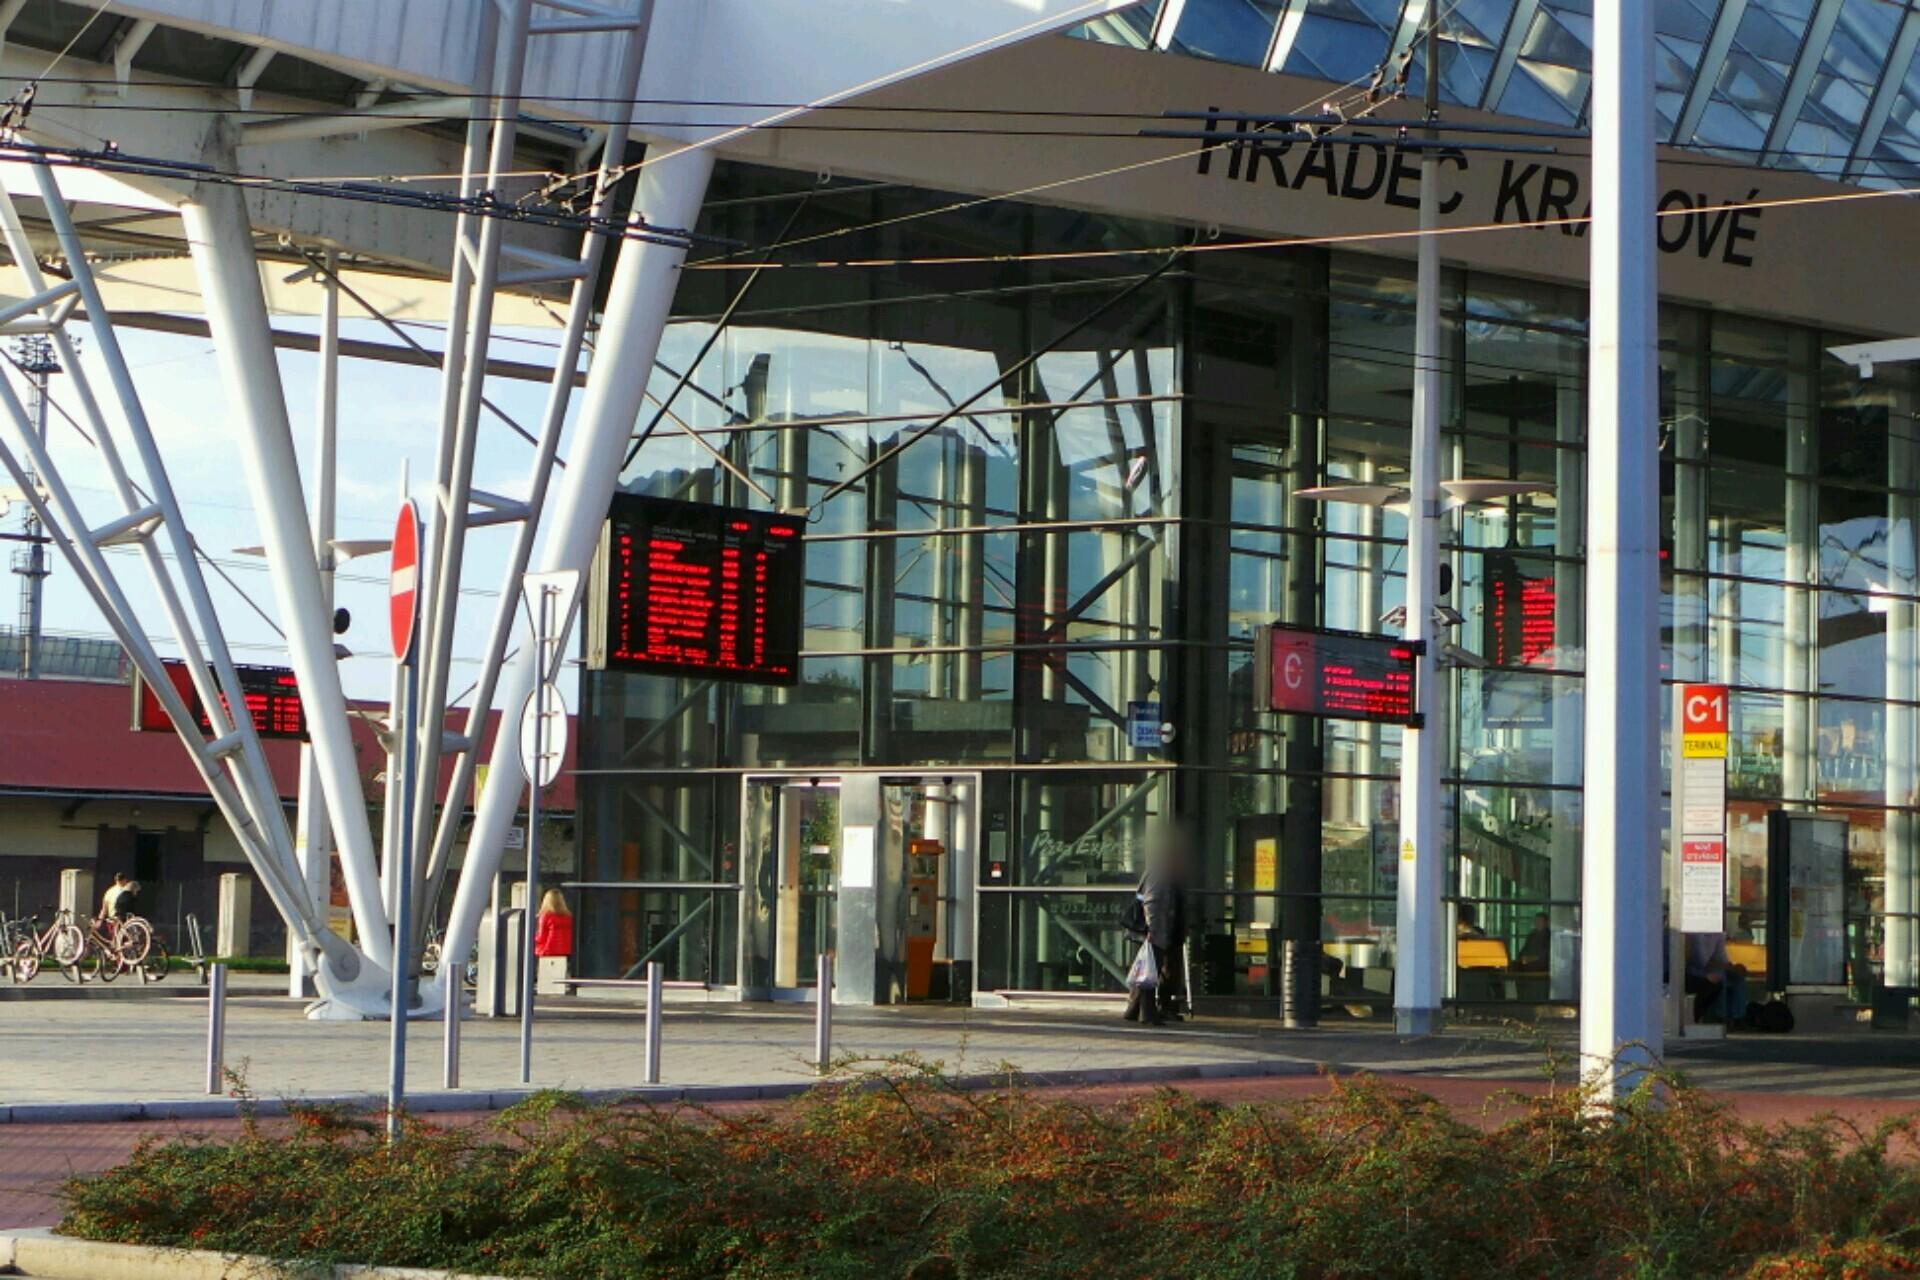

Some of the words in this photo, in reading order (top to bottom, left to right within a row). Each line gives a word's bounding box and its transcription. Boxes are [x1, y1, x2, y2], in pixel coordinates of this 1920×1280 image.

[1196, 106, 1468, 214] HRADEC
[1494, 159, 1763, 268] KROVÉ
[1284, 651, 1302, 689] C
[1686, 695, 1723, 724] C1
